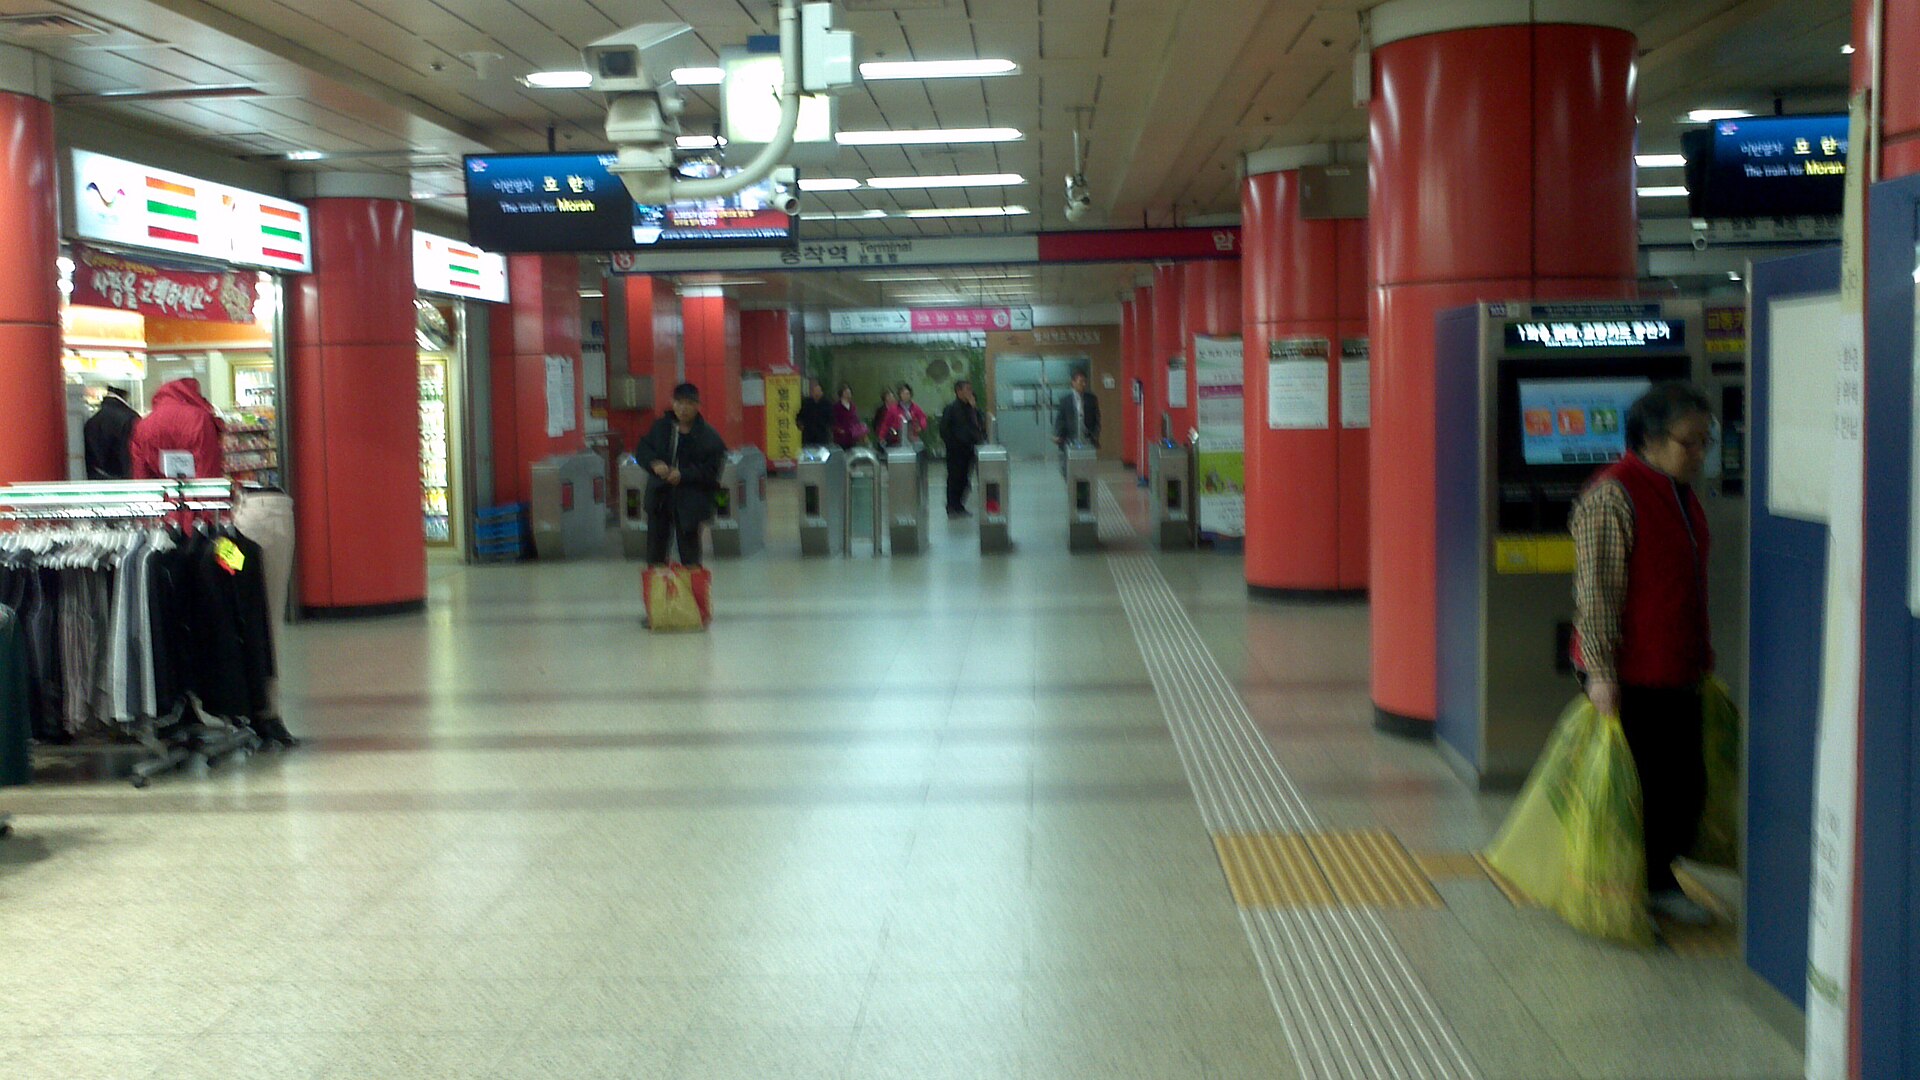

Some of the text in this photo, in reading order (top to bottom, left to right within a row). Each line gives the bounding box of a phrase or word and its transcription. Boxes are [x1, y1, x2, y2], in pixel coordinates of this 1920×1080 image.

[1745, 160, 1846, 177] The train for Moran
[500, 199, 596, 213] The train for Moran
[860, 241, 912, 254] Terminal
